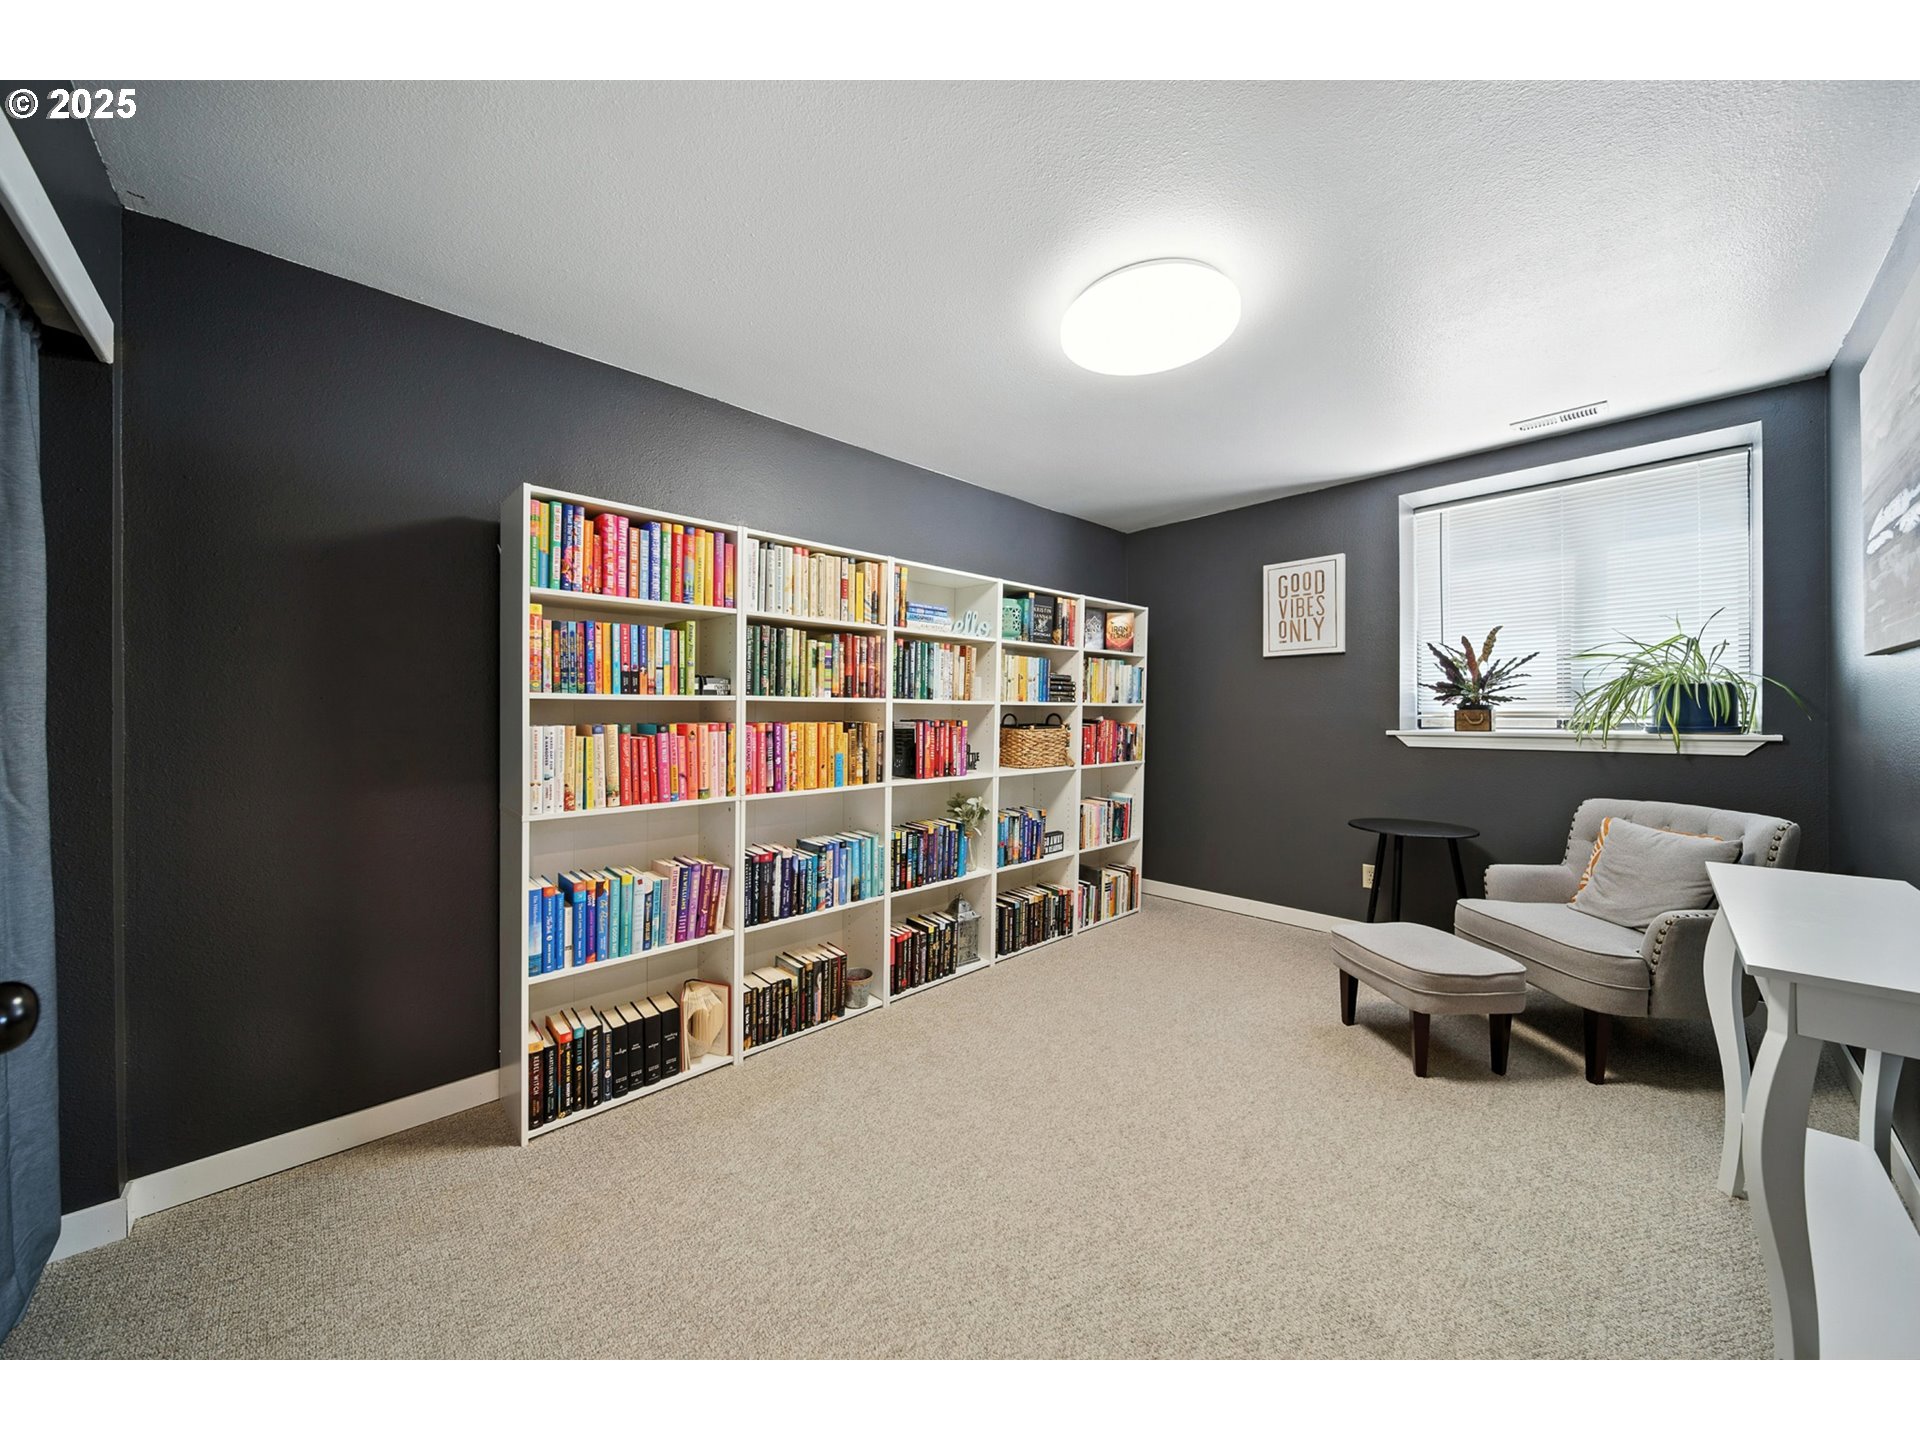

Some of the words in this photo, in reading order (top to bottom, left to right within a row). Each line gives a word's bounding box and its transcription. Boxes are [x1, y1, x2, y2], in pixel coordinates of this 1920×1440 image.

[1278, 570, 1325, 599] GOOD
[1279, 595, 1325, 619] VIBES
[1279, 617, 1325, 643] ONLY
[671, 899, 676, 907] US
